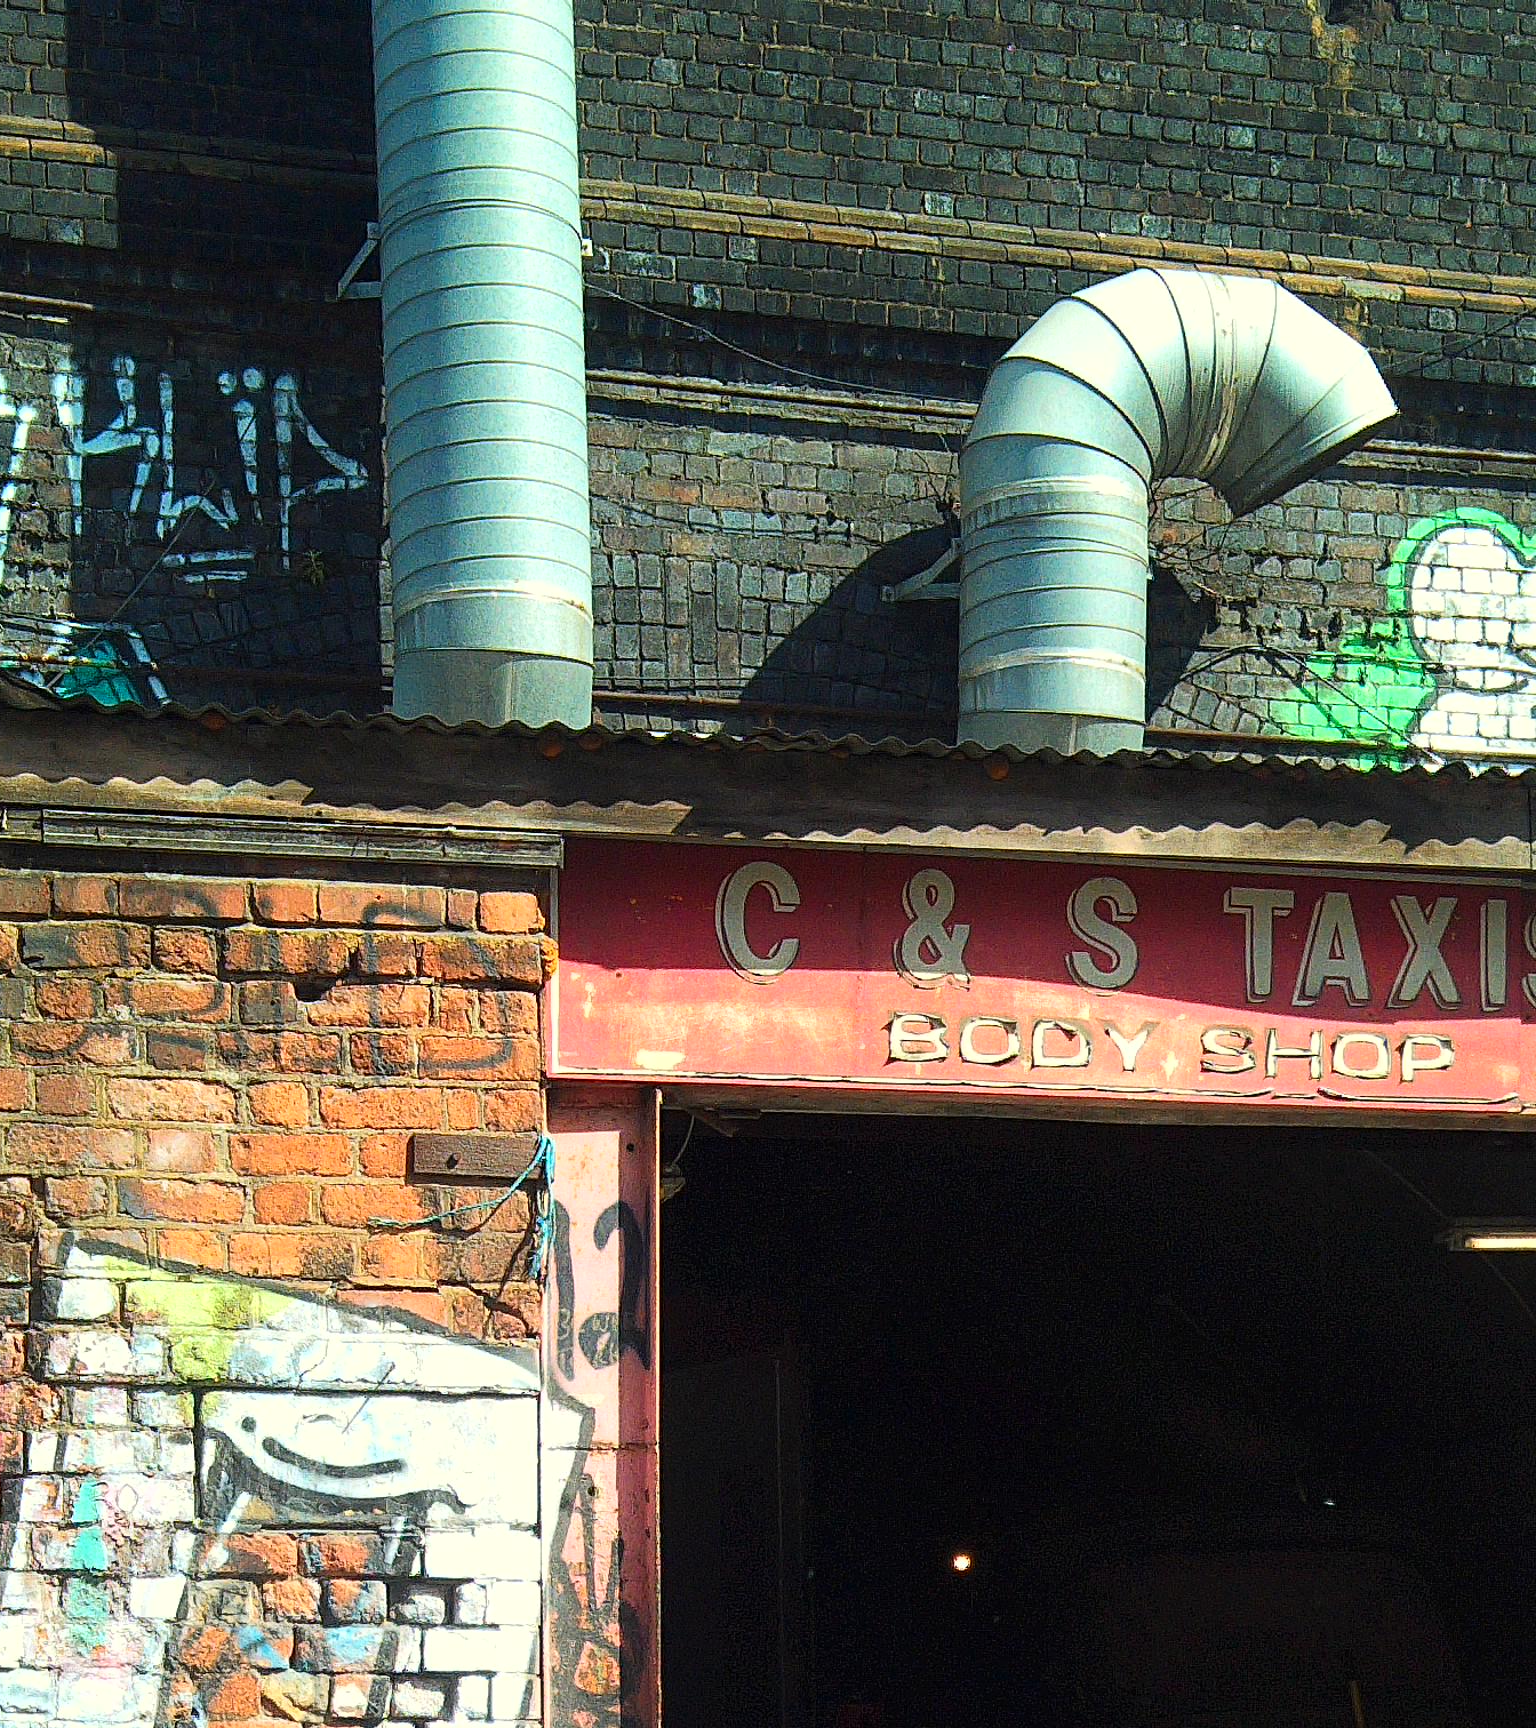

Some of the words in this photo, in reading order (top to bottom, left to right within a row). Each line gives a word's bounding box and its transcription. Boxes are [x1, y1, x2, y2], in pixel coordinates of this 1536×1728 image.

[715, 860, 802, 985] C
[894, 868, 971, 991] &
[1065, 876, 1139, 996] S
[882, 1011, 1160, 1074] BODY
[1199, 1026, 1457, 1084] SHOP
